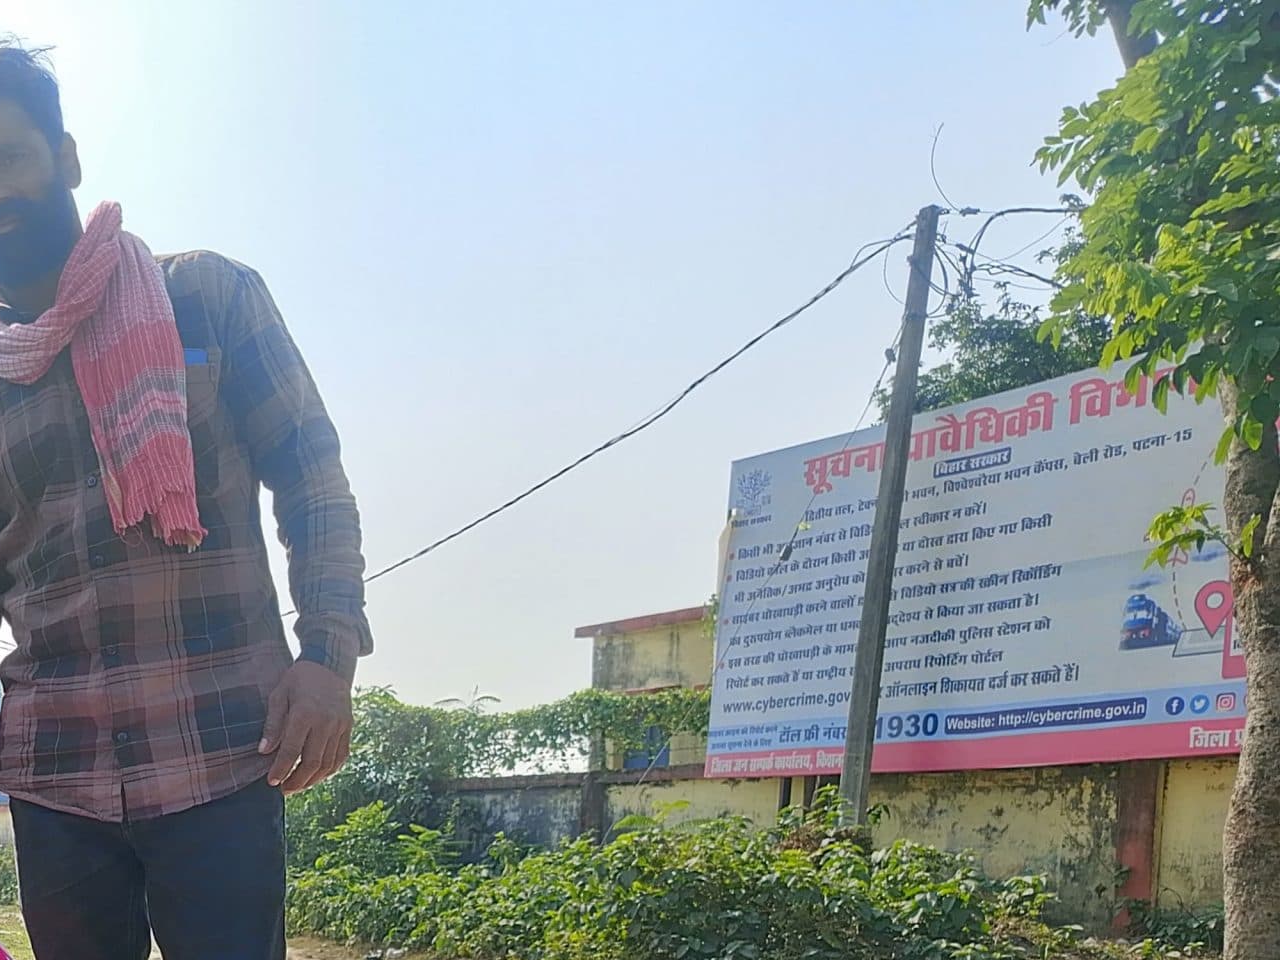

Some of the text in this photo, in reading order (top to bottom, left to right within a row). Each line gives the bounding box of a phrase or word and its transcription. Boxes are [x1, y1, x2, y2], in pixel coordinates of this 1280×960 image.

[804, 442, 887, 495] सूचना
[912, 484, 938, 500] भवन,
[1004, 465, 1031, 480] भवन
[738, 545, 760, 559] किसी
[838, 528, 846, 540] से
[952, 507, 962, 519] न
[831, 549, 855, 563] किसी
[903, 540, 913, 551] या
[1021, 513, 1052, 530] किसी
[934, 557, 943, 570] से
[825, 622, 836, 633] या
[924, 606, 933, 619] से
[937, 603, 963, 618] किया
[968, 602, 982, 614] जा
[987, 597, 1020, 611] सकता
[910, 628, 954, 645] नजदीकी
[959, 624, 992, 643] पुलिस
[1034, 616, 1051, 630] को
[886, 677, 937, 699] ऑनलाइन
[940, 673, 985, 694] शिकायत
[1011, 671, 1027, 687] कर
[1031, 665, 1061, 685] सकते
[722, 688, 850, 715] www.cybercrime.gov
[946, 701, 1145, 731] Website: http://cybercrime.gov.in
[778, 726, 801, 743] टॉल
[876, 712, 939, 740] 1930
[1189, 726, 1231, 749] जिला
